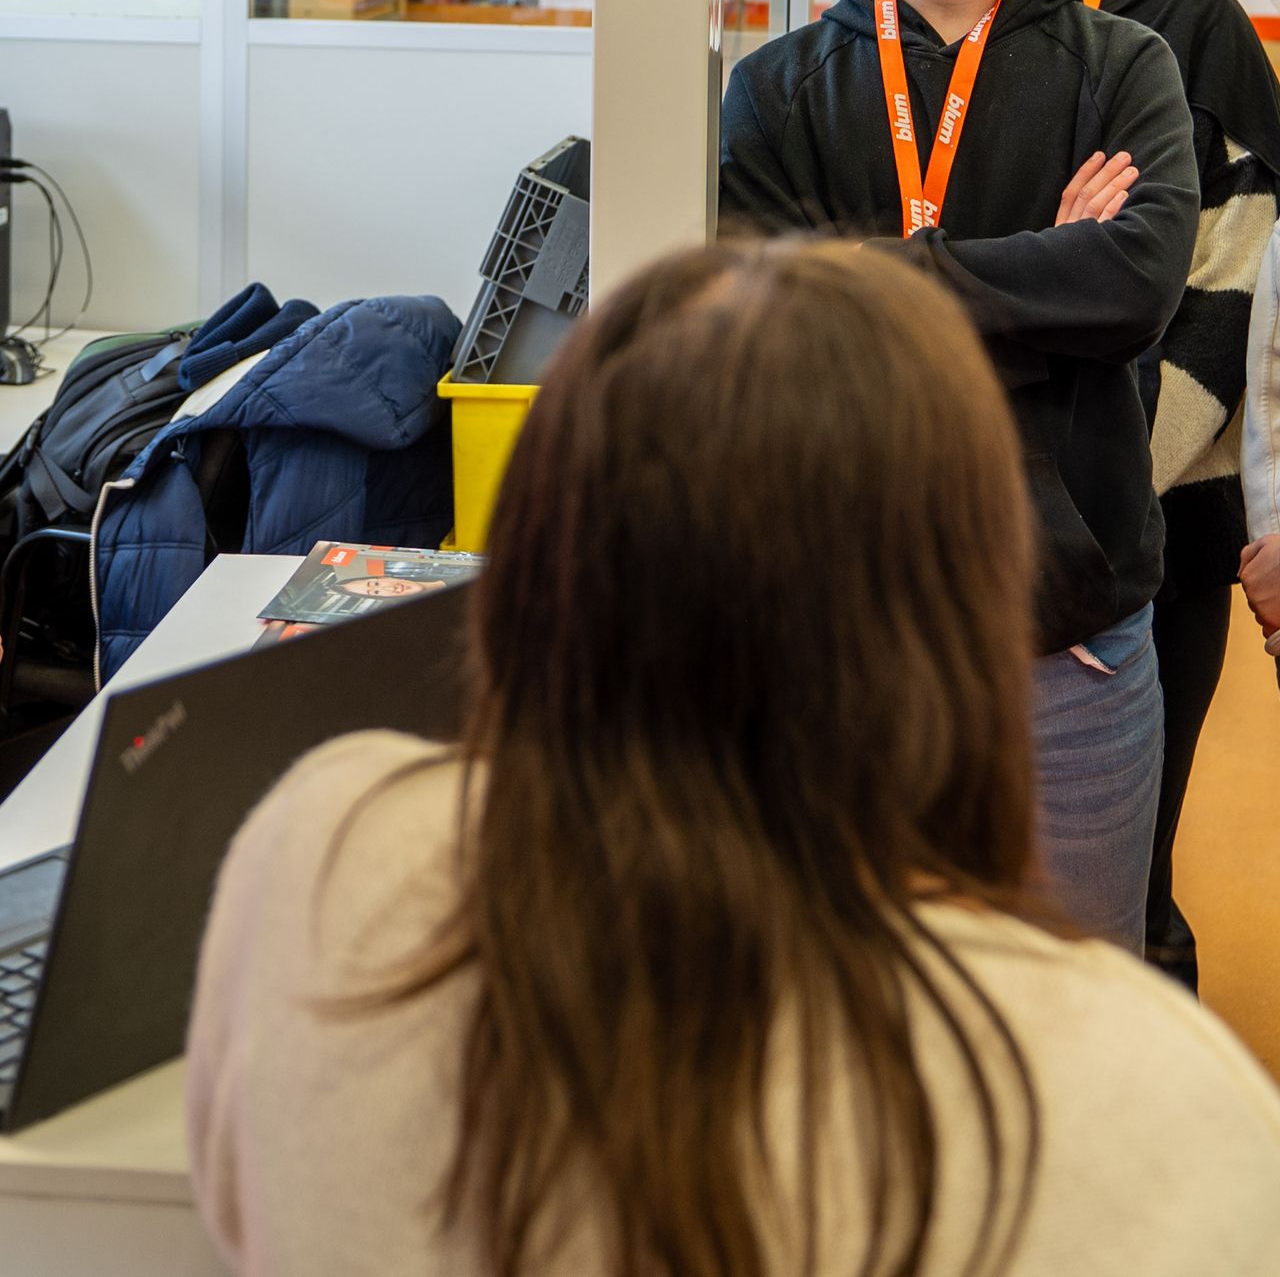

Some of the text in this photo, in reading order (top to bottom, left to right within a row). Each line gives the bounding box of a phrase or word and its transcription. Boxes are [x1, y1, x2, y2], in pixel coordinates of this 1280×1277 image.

[880, 1, 897, 40] blum
[894, 93, 913, 142] blum
[938, 92, 965, 145] blum
[908, 198, 922, 236] um
